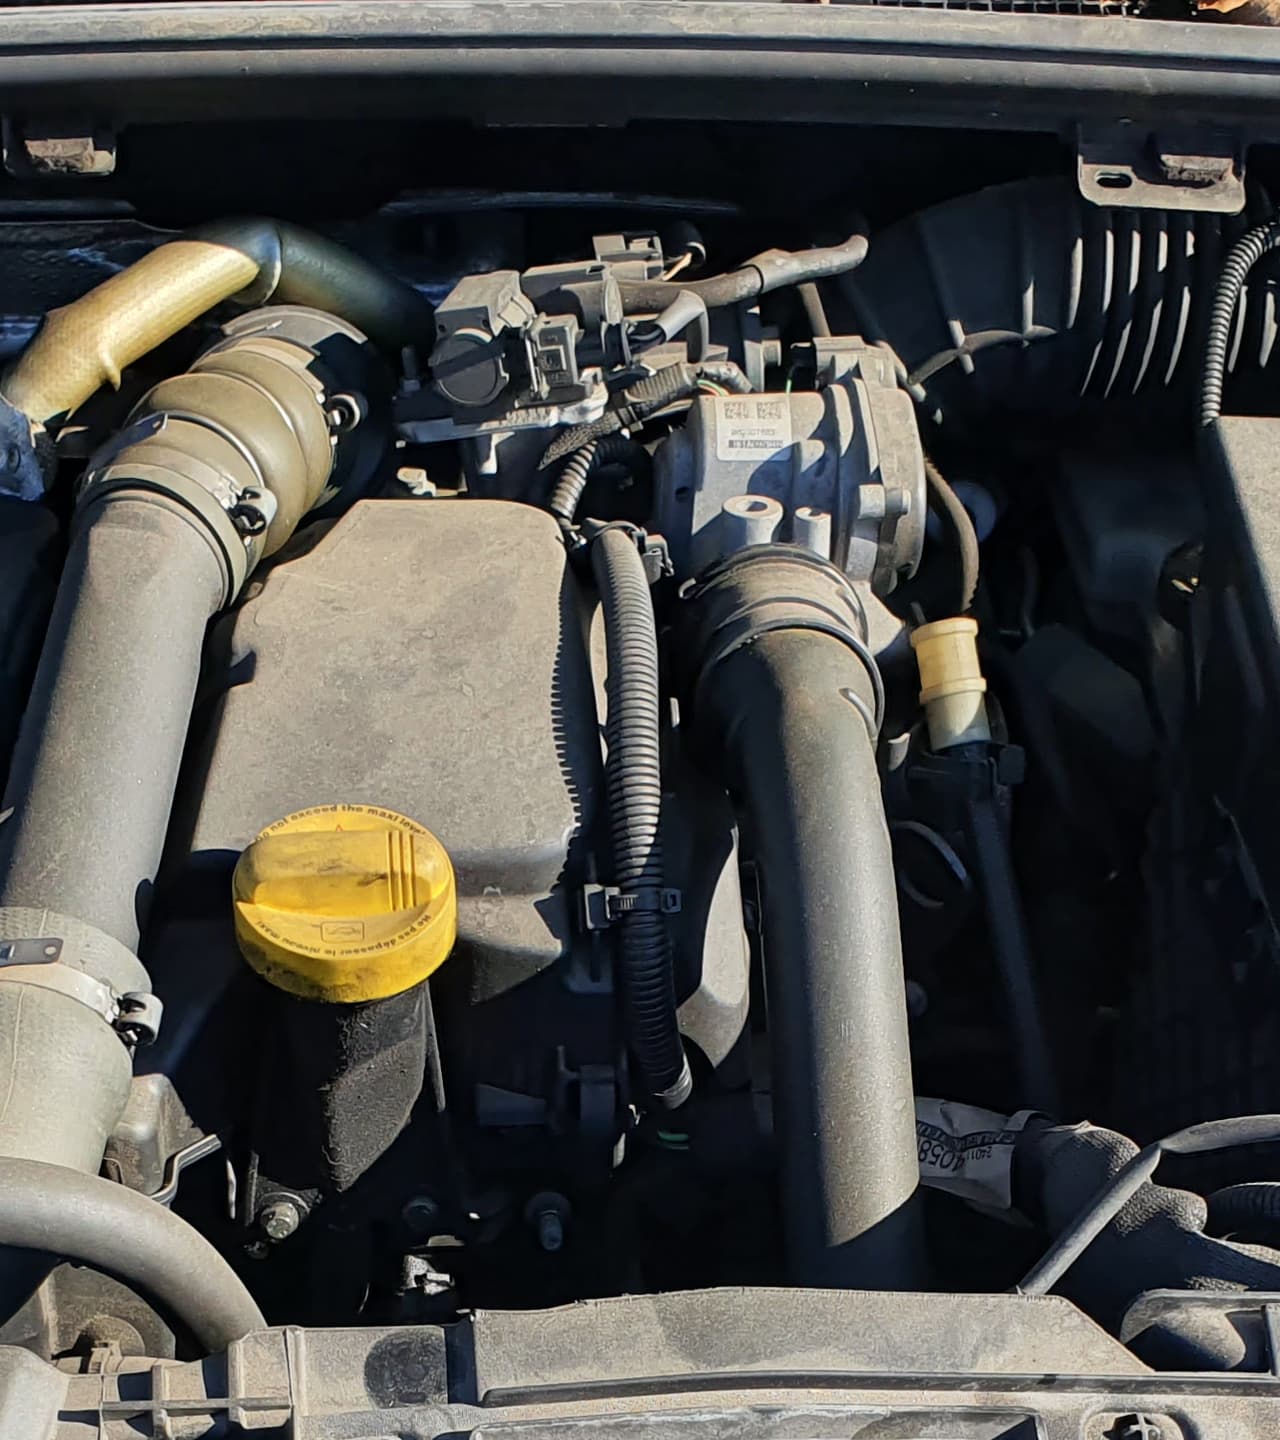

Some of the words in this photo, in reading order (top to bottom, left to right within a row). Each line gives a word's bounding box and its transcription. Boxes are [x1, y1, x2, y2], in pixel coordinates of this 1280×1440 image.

[270, 818, 289, 832] not
[291, 805, 337, 821] exceed
[341, 804, 363, 812] the
[368, 808, 399, 822] maxi
[398, 926, 416, 940] pas
